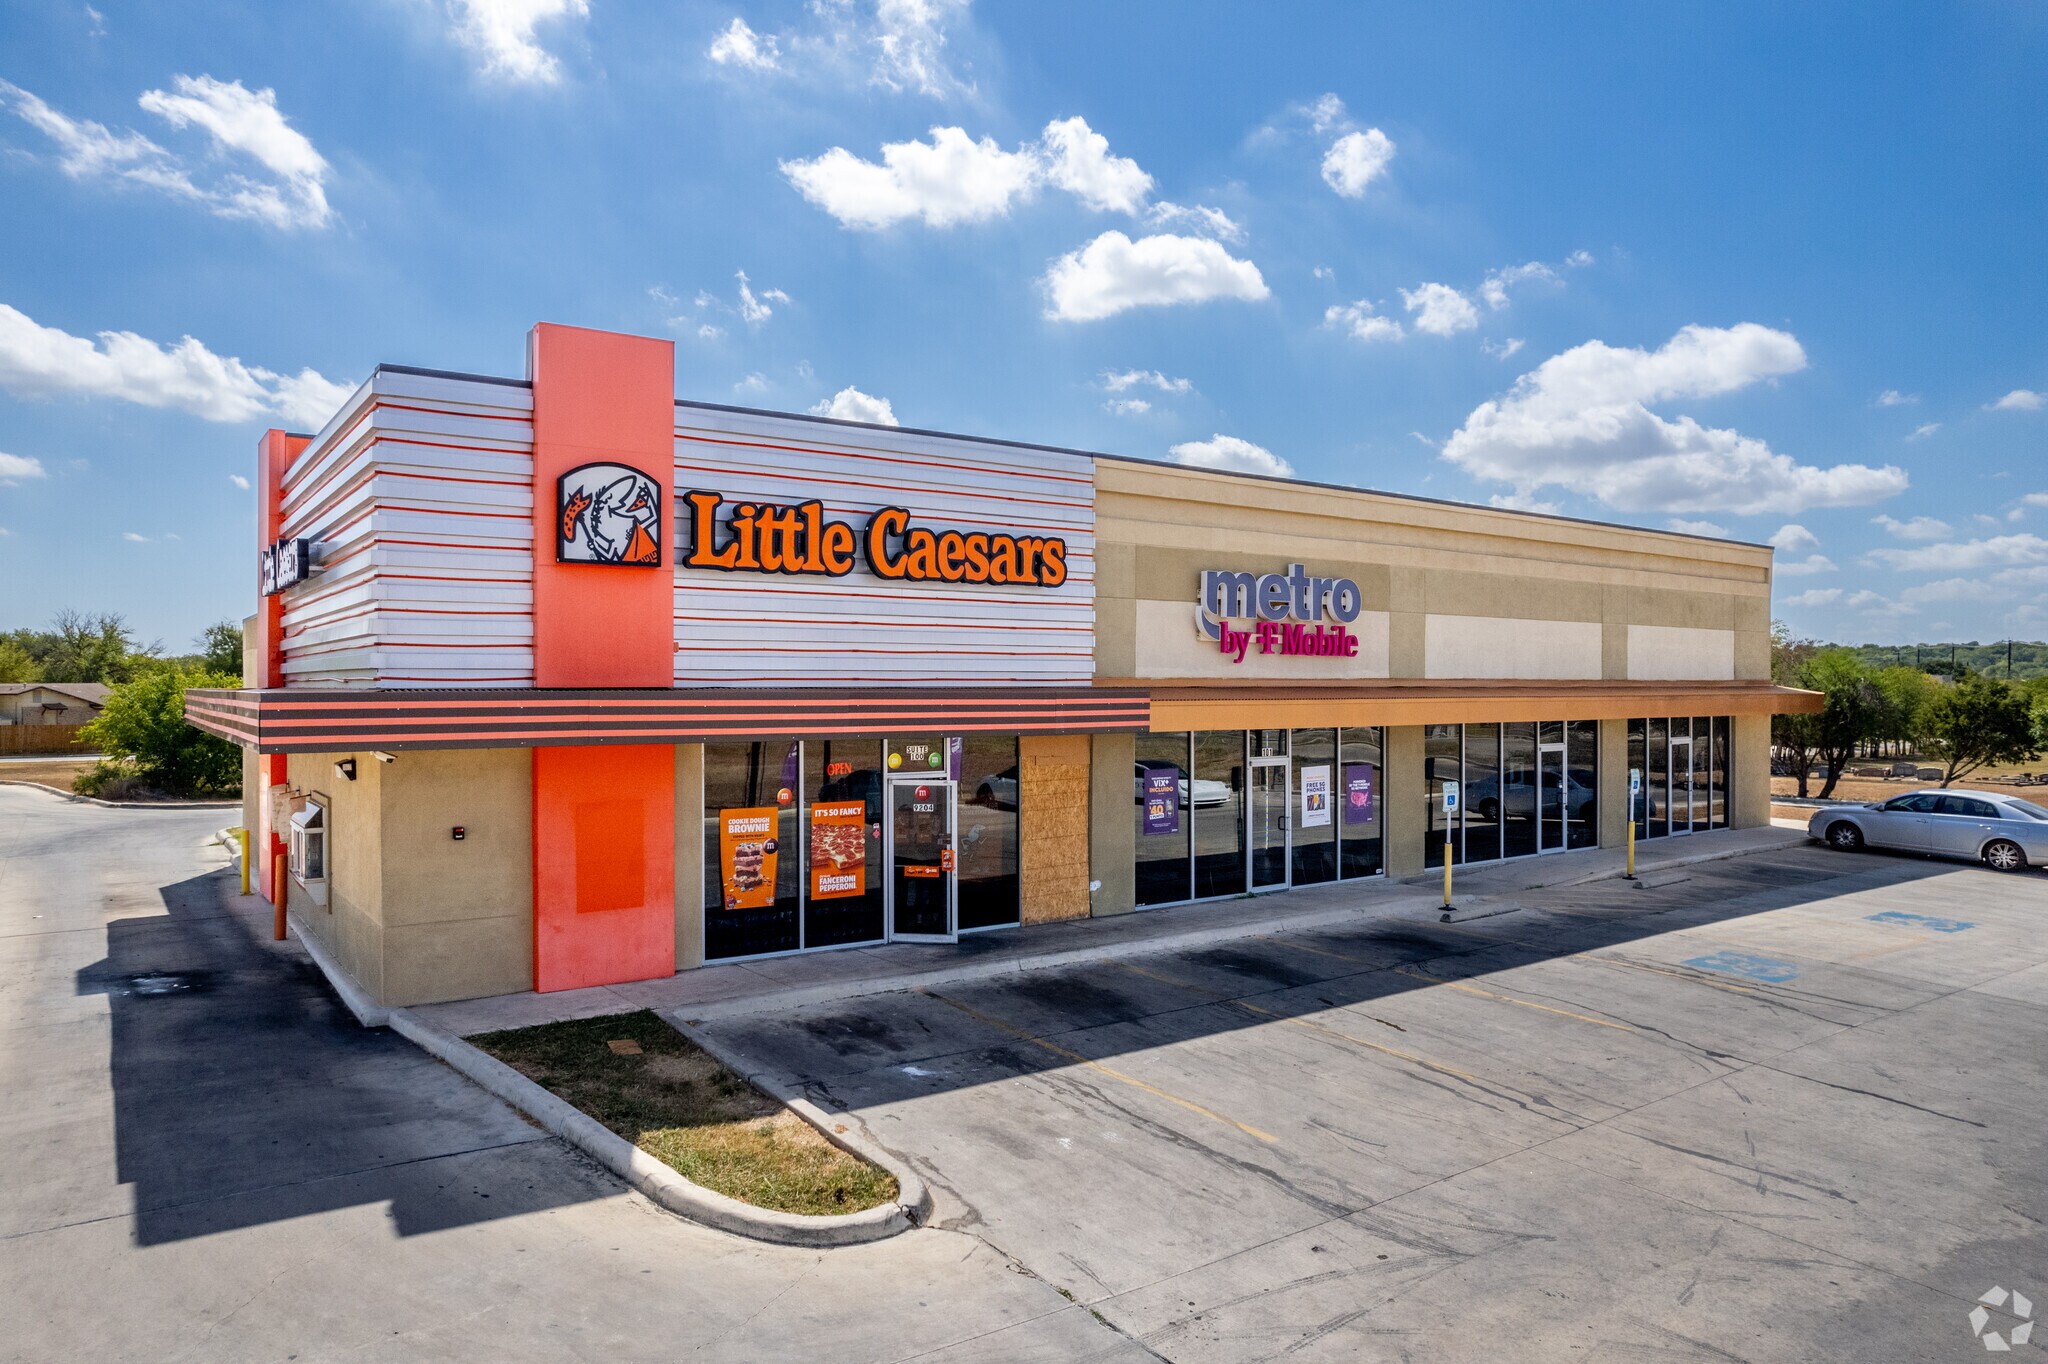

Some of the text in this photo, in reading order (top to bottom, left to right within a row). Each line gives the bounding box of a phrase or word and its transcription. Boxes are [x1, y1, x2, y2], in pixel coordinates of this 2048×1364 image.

[684, 490, 1067, 587] Little Caesars
[1201, 563, 1362, 623] metro
[1219, 621, 1252, 663] by
[827, 763, 852, 775] OPEN
[815, 807, 862, 817] IT'S SO FANCY
[728, 823, 770, 833] BROWNIE
[819, 874, 856, 885] FANCERONI
[819, 882, 857, 892] PEPPERONI
